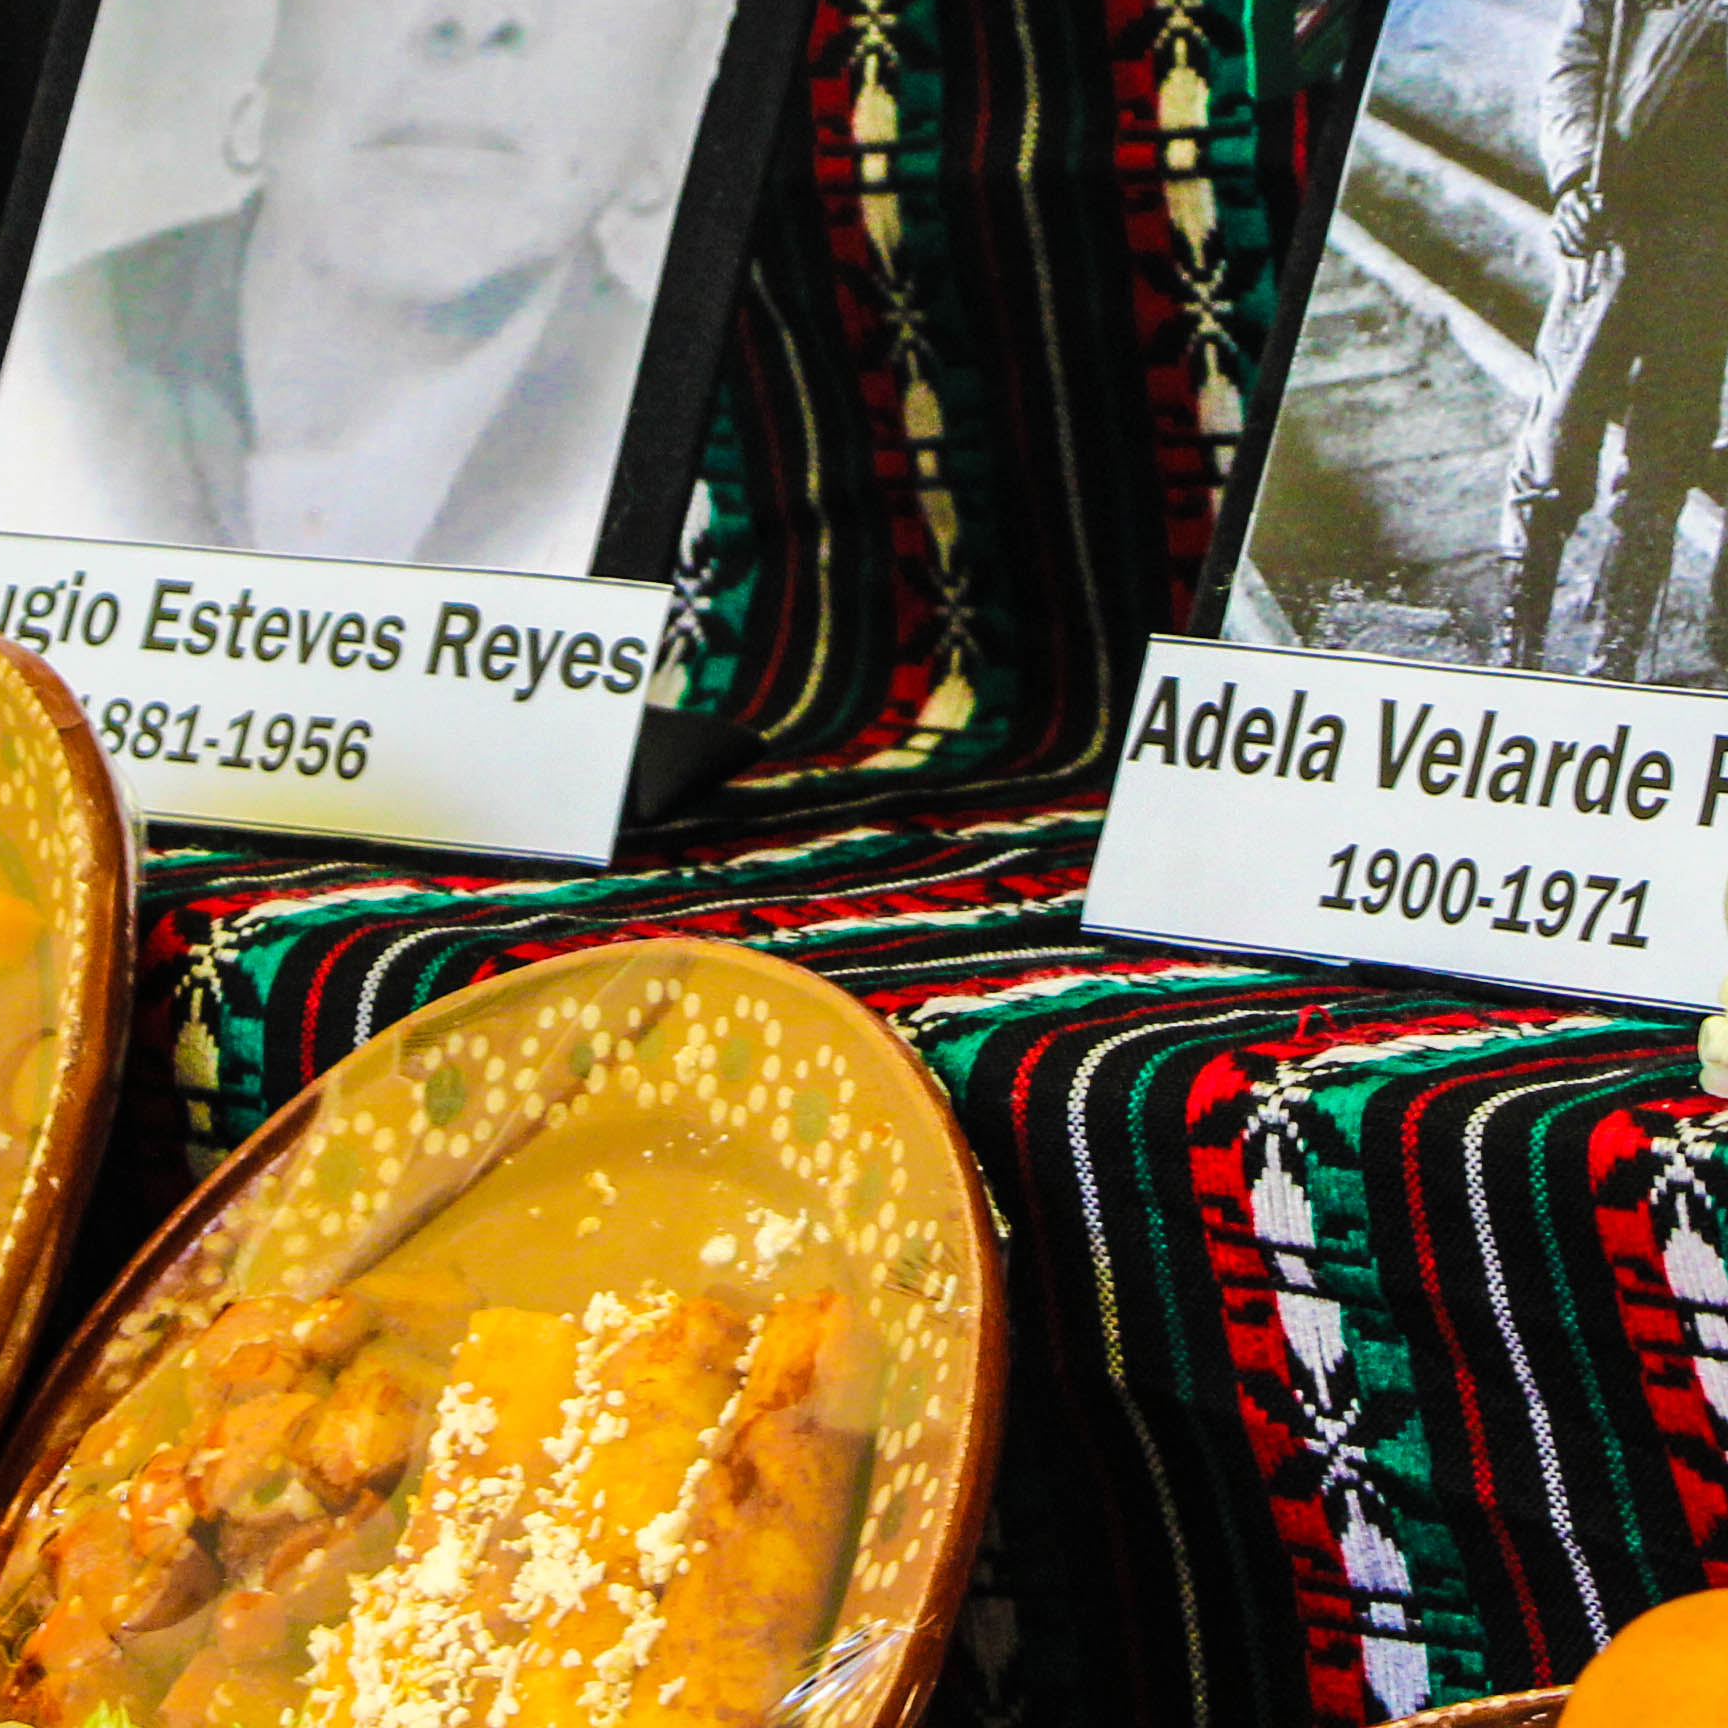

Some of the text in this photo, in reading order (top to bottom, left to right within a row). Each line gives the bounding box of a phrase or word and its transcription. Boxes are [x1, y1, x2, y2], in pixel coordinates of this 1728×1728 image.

[139, 578, 408, 673] Esteves
[424, 601, 649, 703] Reyes
[80, 694, 374, 780] 881-1956
[1127, 675, 1348, 784] Adela
[1377, 697, 1676, 822] Velarde
[1318, 843, 1652, 950] 1900-1971
